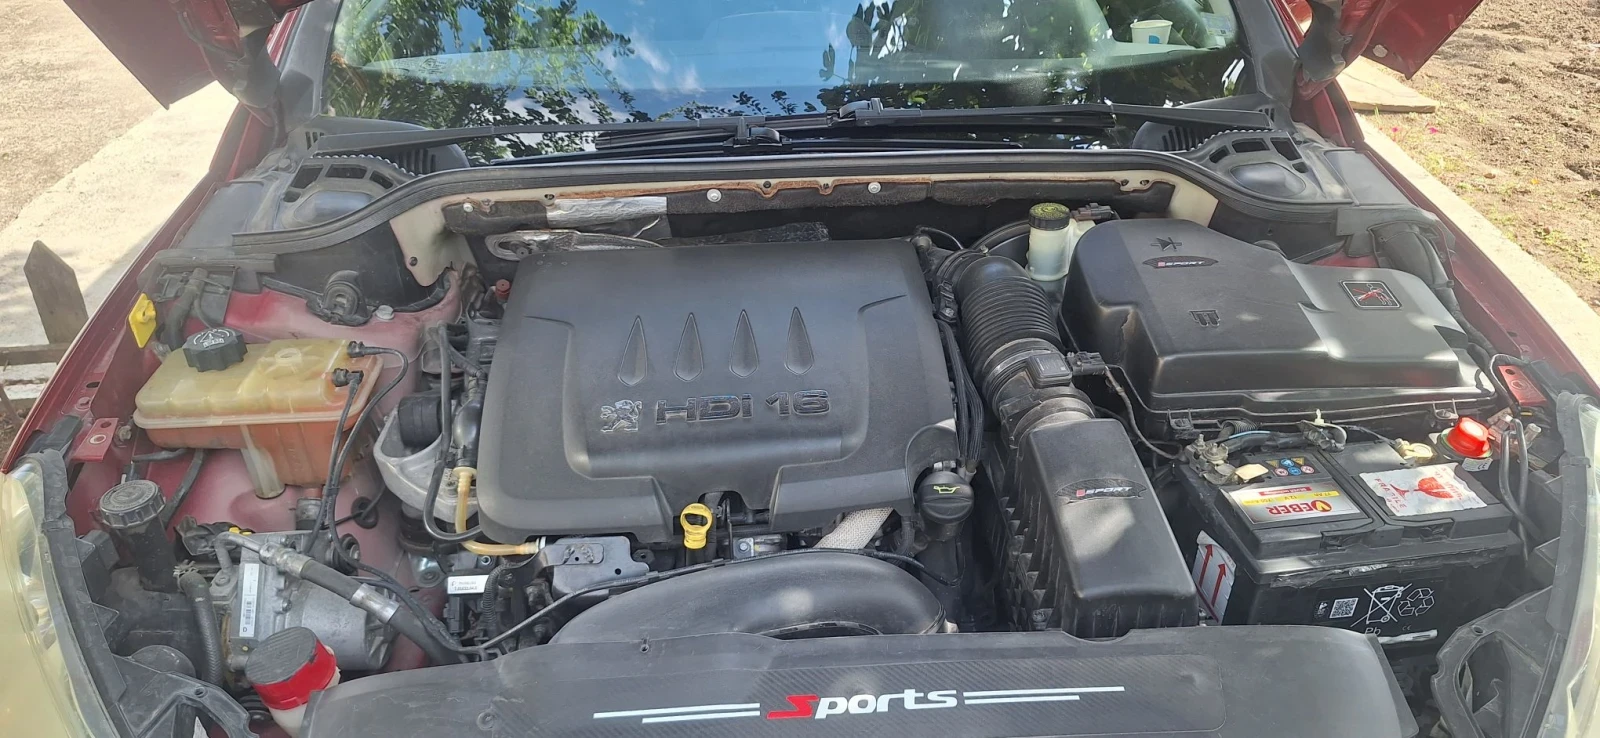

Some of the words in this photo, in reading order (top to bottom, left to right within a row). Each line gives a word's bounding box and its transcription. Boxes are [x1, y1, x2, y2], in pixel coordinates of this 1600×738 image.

[655, 393, 752, 425] HDi
[765, 389, 830, 416] 16
[1266, 500, 1332, 515] VEBER
[1375, 478, 1407, 508] FRAILE
[1365, 627, 1381, 636] Pb
[766, 688, 957, 720] Sports
